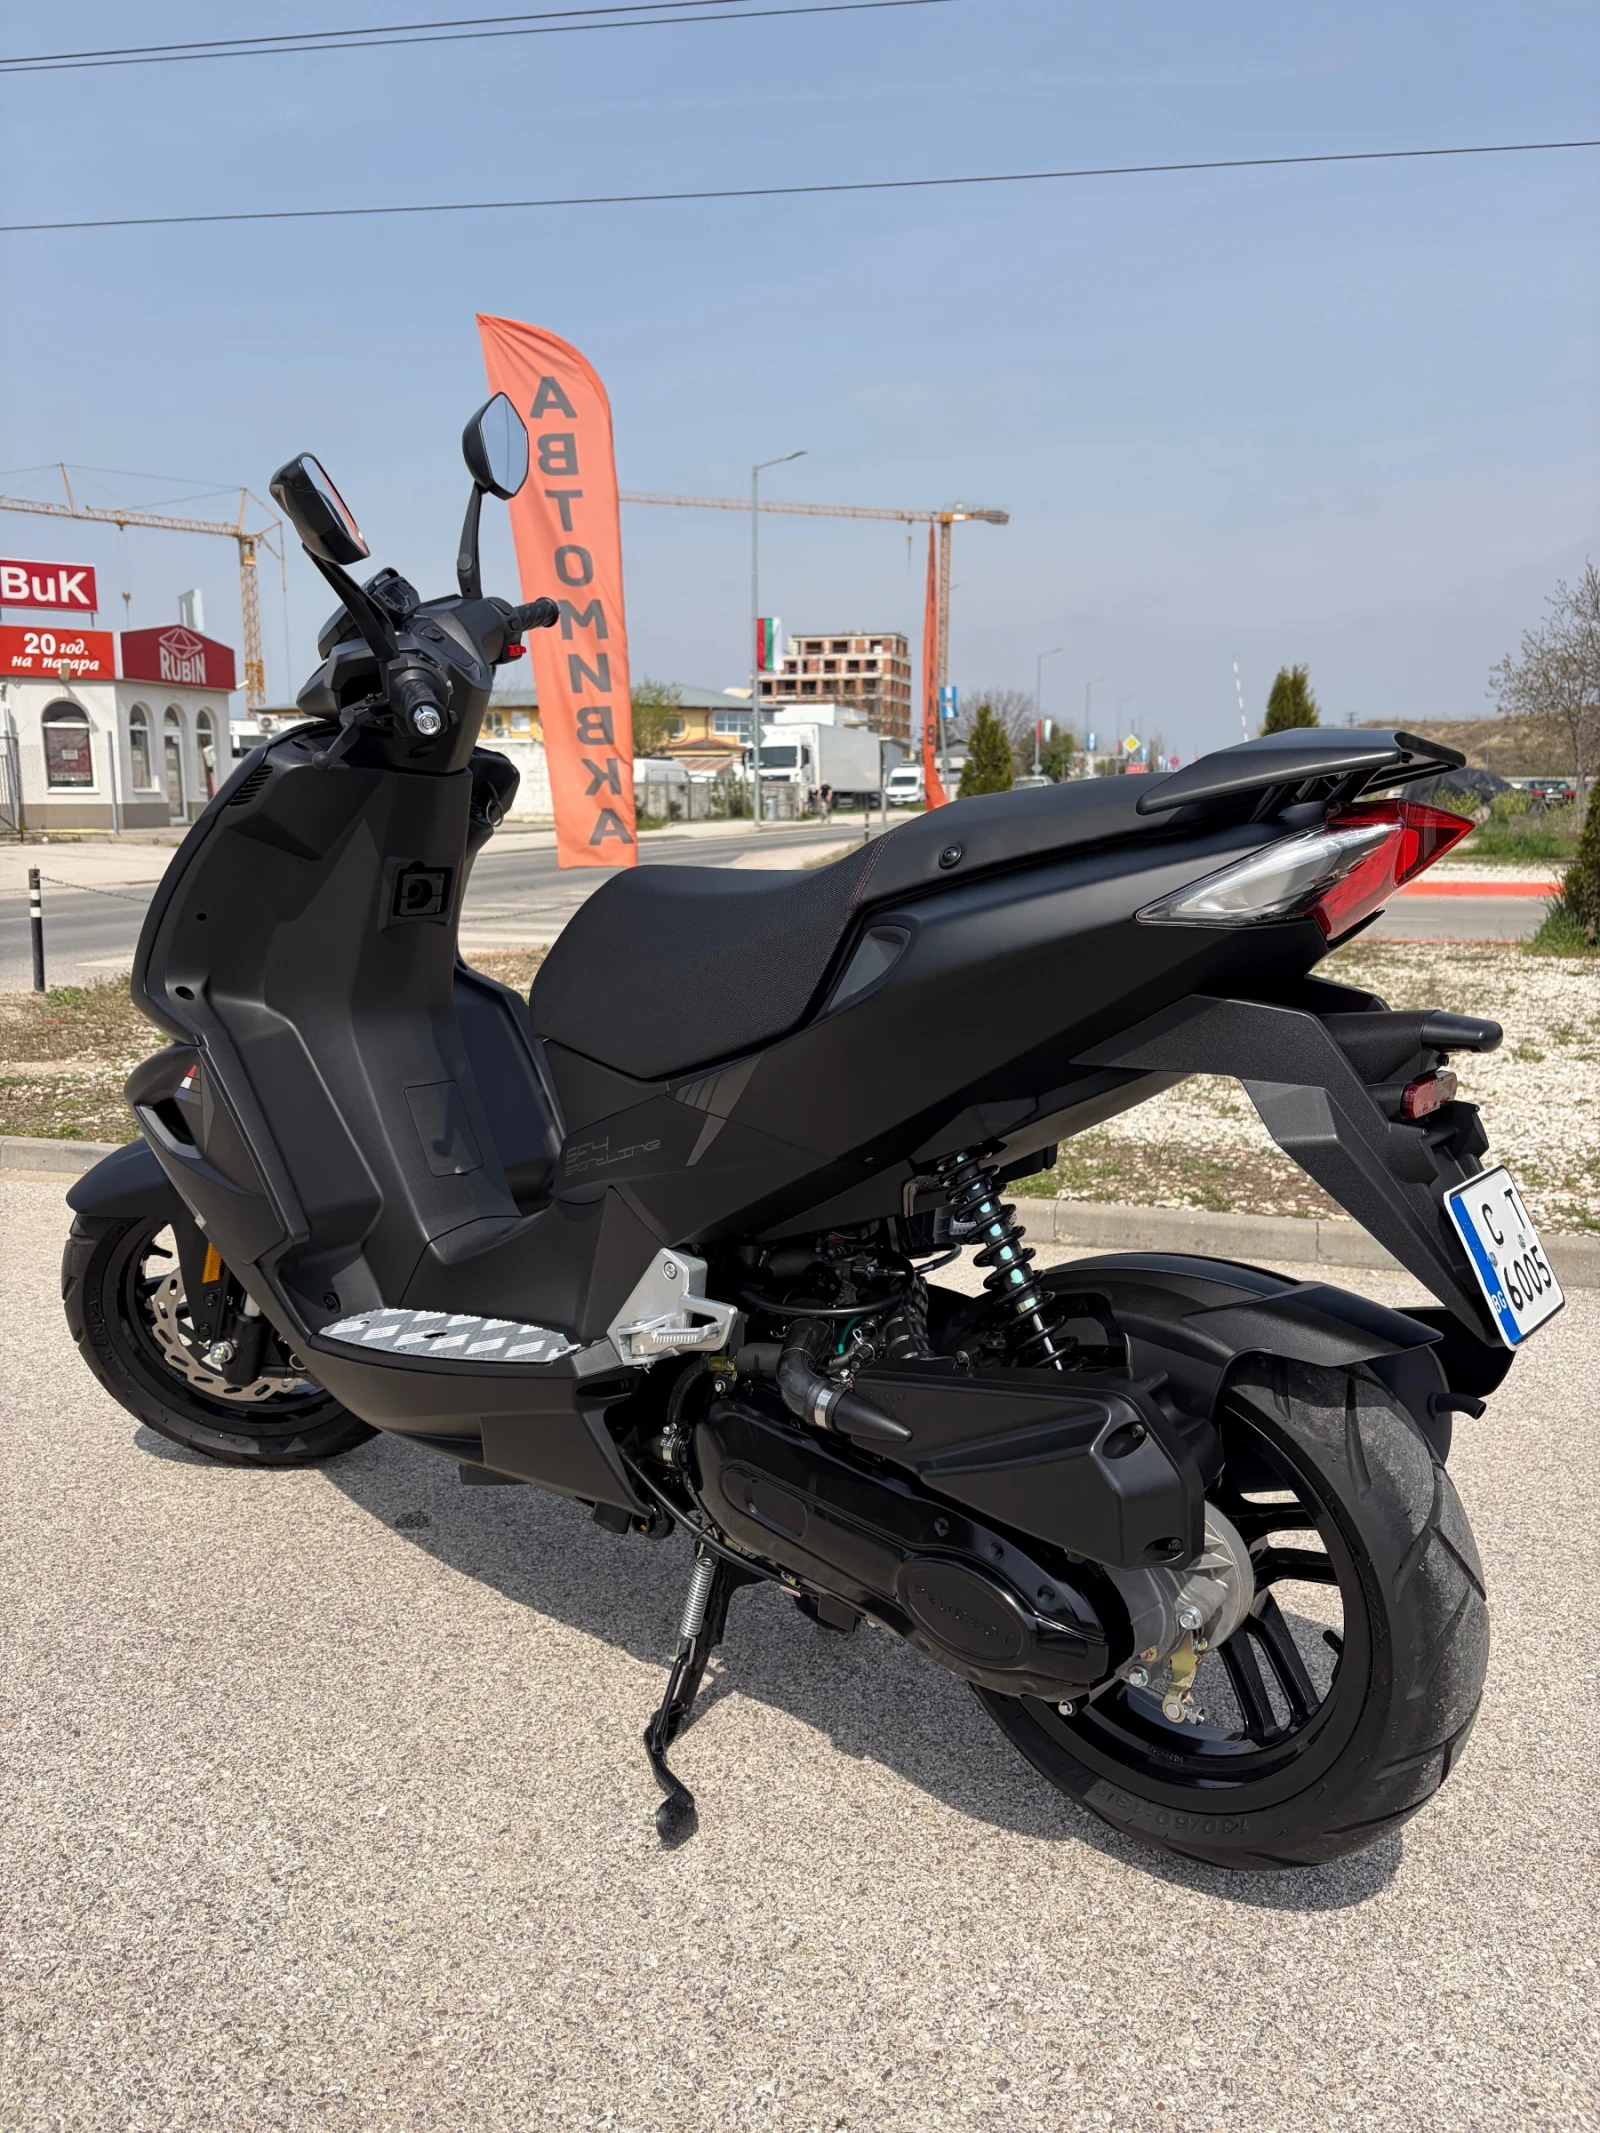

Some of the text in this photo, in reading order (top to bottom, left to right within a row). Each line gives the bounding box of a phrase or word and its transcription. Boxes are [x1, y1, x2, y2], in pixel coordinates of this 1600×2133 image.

[23, 632, 56, 655] 20
[11, 656, 32, 668] на
[159, 646, 207, 684] RUBIN
[1481, 1203, 1505, 1246] C
[1503, 1244, 1552, 1312] 6005
[1491, 1290, 1508, 1314] BG
